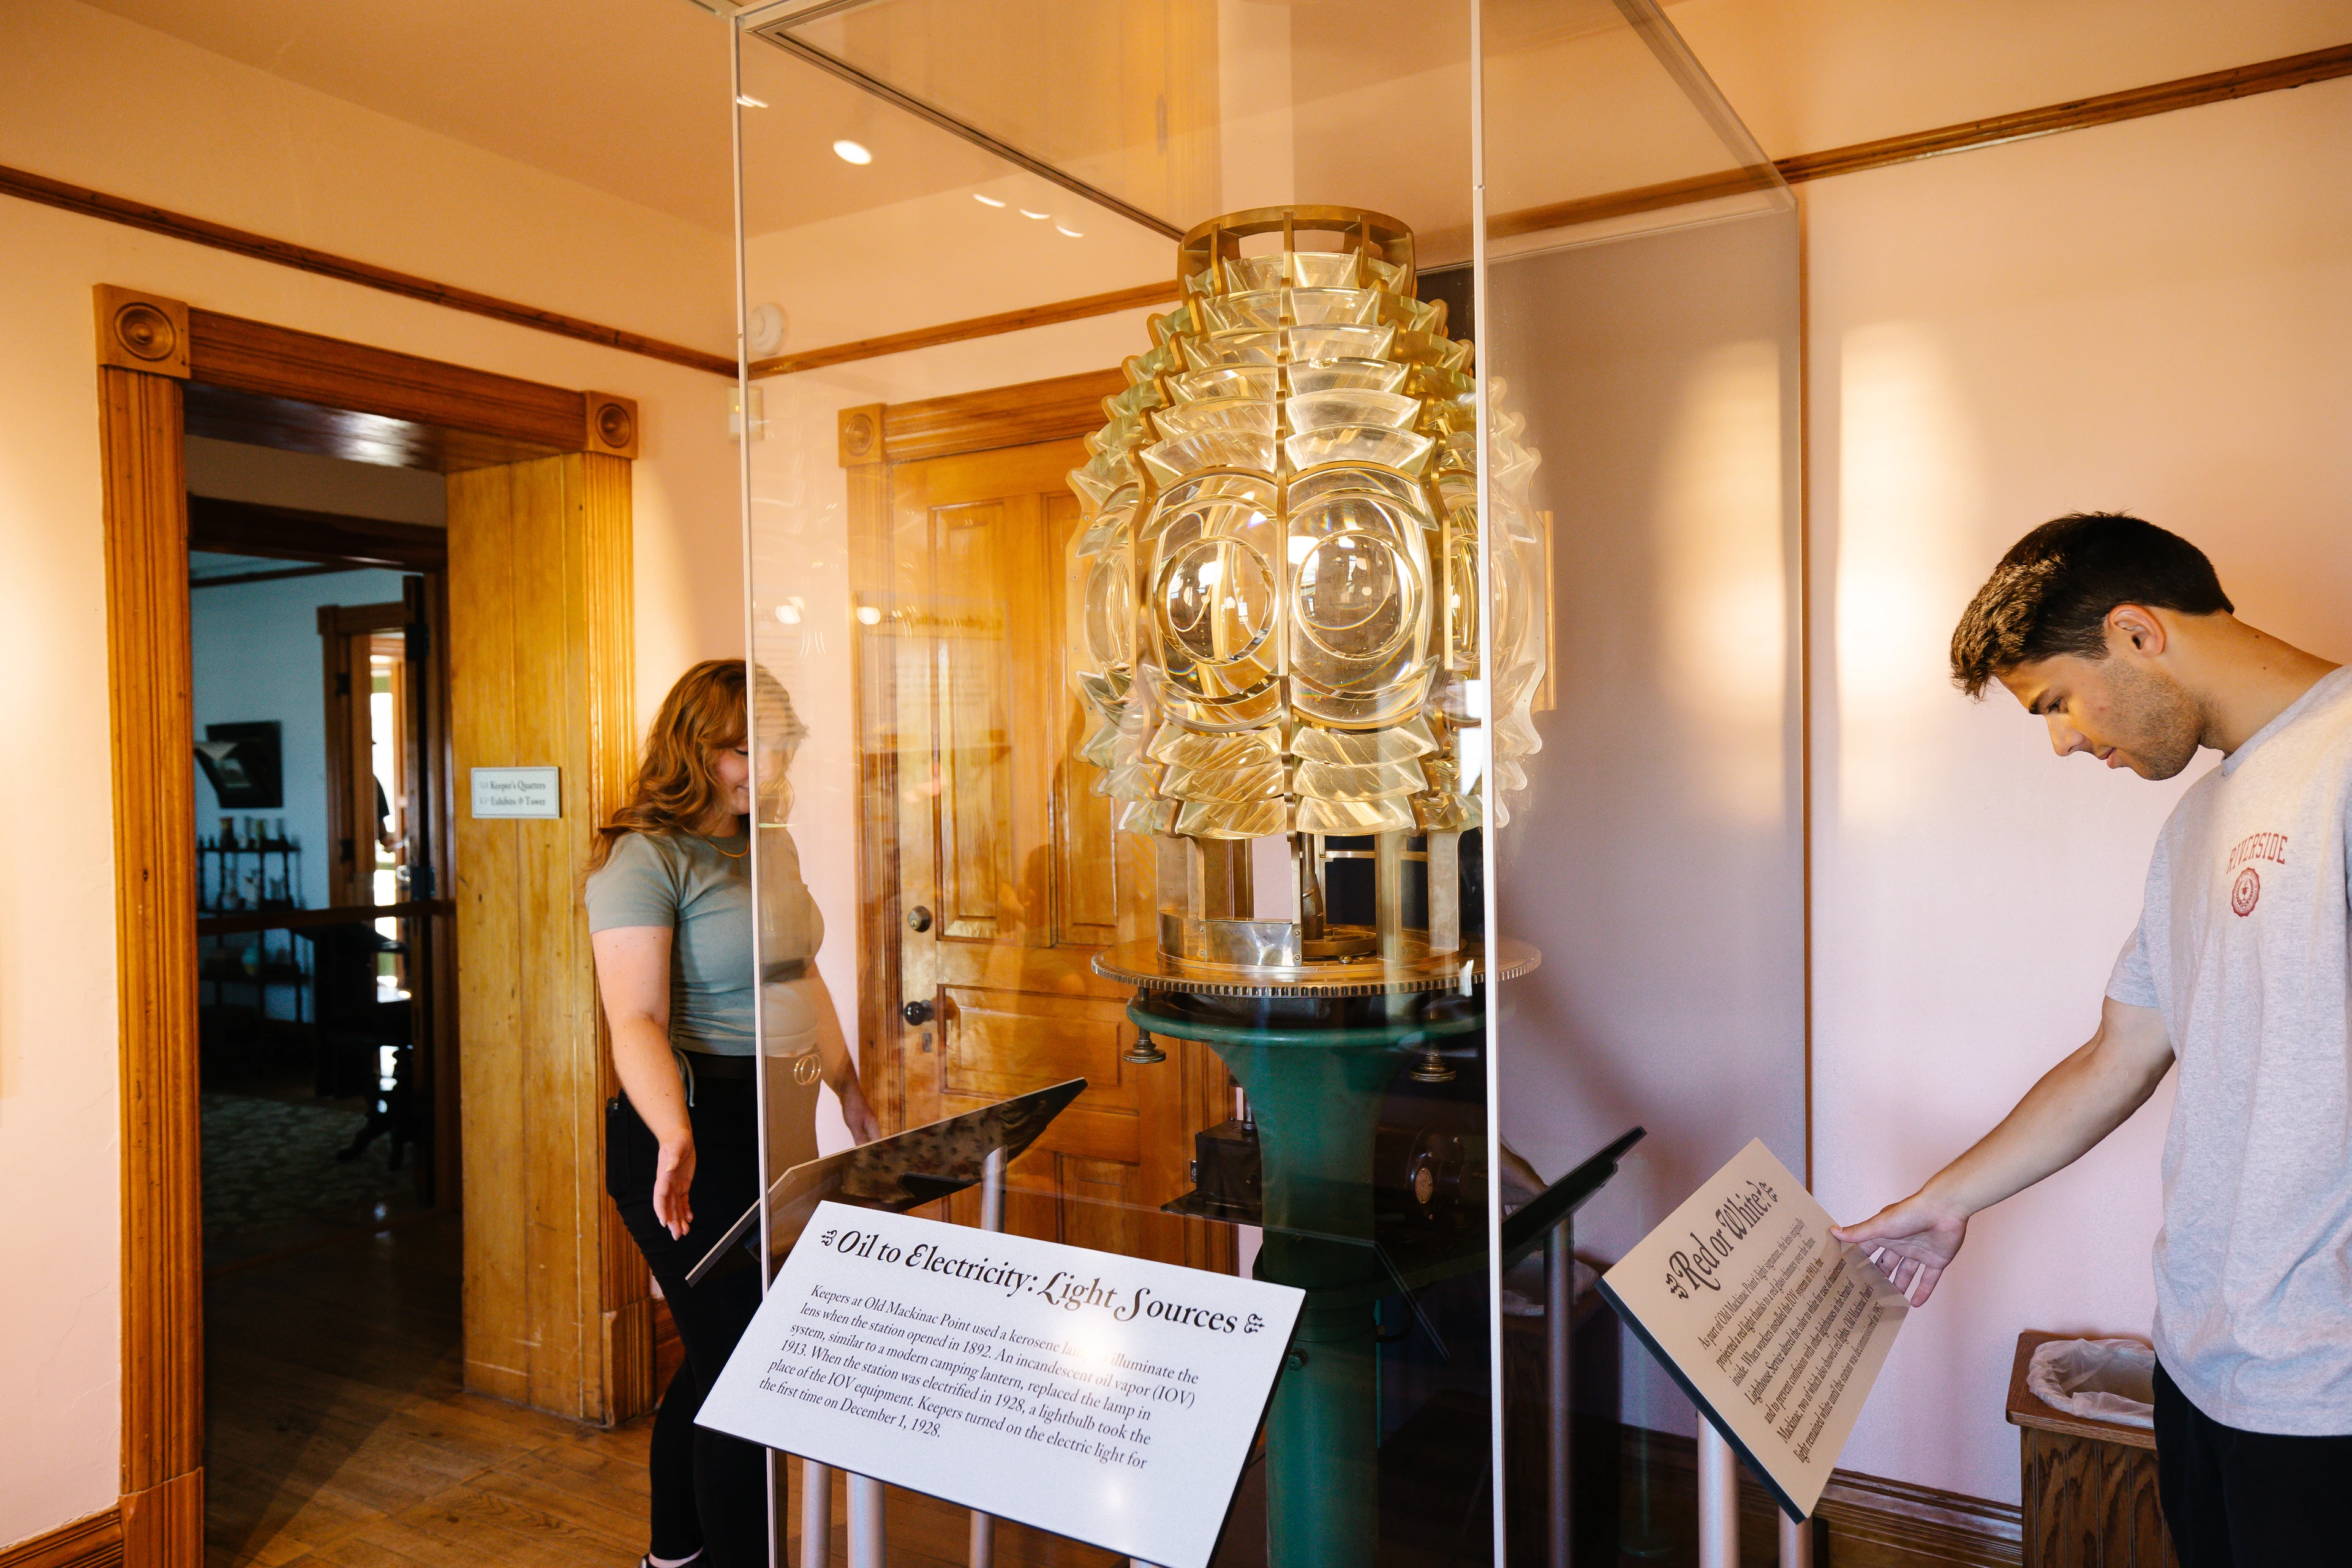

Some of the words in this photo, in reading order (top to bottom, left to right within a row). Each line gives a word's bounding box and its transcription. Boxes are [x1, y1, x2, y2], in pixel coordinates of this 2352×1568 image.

[489, 780, 516, 792] Keeper's
[517, 780, 546, 791] Quarters
[525, 796, 546, 805] Tower
[2226, 832, 2288, 875] RIVERSIDE
[1715, 1180, 1772, 1240] White?
[1709, 1228, 1735, 1257] or
[1776, 1241, 1788, 1252] the
[1781, 1234, 1793, 1246] lens
[1802, 1237, 1816, 1250] flame
[1763, 1249, 1784, 1271] signature,
[1794, 1252, 1804, 1264] over
[1798, 1246, 1809, 1256] the
[1668, 1232, 1721, 1291] Red
[1780, 1260, 1800, 1280] chimney
[1806, 1262, 1821, 1279] 1913,
[1813, 1257, 1824, 1268] the
[1753, 1265, 1768, 1281] light
[1802, 1274, 1812, 1284] in
[837, 1231, 880, 1258] Oil
[876, 1242, 902, 1263] to
[905, 1243, 1038, 1298] Electricity:
[1036, 1272, 1117, 1311] Light
[1113, 1287, 1238, 1334] Sources
[1741, 1273, 1760, 1294] Point's
[1770, 1282, 1779, 1298] red
[1773, 1276, 1786, 1294] glass
[1795, 1279, 1809, 1299] system
[1820, 1284, 1830, 1297] ease
[1823, 1276, 1833, 1289] of
[1847, 1276, 1855, 1289] of
[1762, 1297, 1771, 1306] to
[1784, 1288, 1799, 1308] IOV
[1812, 1292, 1824, 1304] for
[1837, 1284, 1852, 1302] Straits
[1724, 1289, 1749, 1316] Mackinac
[1749, 1300, 1767, 1321] thanks
[1781, 1302, 1792, 1314] the
[1806, 1299, 1820, 1315] white
[1830, 1304, 1841, 1314] in
[1833, 1297, 1844, 1308] the
[1848, 1297, 1867, 1322] Mackinac
[1714, 1316, 1724, 1331] of
[1717, 1307, 1732, 1325] Old
[1740, 1316, 1756, 1333] light
[1767, 1306, 1787, 1334] installed
[1796, 1316, 1809, 1332] color
[1803, 1311, 1812, 1321] to
[1815, 1309, 1838, 1338] lighthouses
[1843, 1313, 1856, 1329] Old
[810, 1284, 851, 1304] Keepers
[851, 1298, 864, 1306] at
[864, 1297, 888, 1312] Old
[884, 1301, 939, 1324] Mackinac
[939, 1313, 971, 1332] Point
[972, 1325, 1001, 1338] used
[999, 1332, 1007, 1340] a
[1008, 1329, 1060, 1352] kerosene
[1111, 1353, 1175, 1379] illuminate
[1177, 1368, 1199, 1384] the
[1706, 1326, 1720, 1346] part
[1734, 1336, 1741, 1344] a
[1737, 1324, 1747, 1341] red
[1756, 1329, 1774, 1352] workers
[1789, 1327, 1801, 1340] the
[1809, 1332, 1823, 1349] other
[1834, 1327, 1851, 1344] lights.
[1851, 1316, 1877, 1357] decommissioned
[1698, 1336, 1711, 1351] As
[1779, 1332, 1796, 1357] altered
[1803, 1343, 1815, 1360] with
[1833, 1335, 1843, 1352] red
[800, 1302, 821, 1317] lens
[823, 1309, 850, 1324] when
[850, 1314, 869, 1329] the
[869, 1322, 905, 1338] station
[907, 1332, 949, 1348] opened
[948, 1337, 960, 1351] in
[962, 1341, 992, 1359] 1892.
[993, 1348, 1014, 1364] An
[1014, 1353, 1093, 1382] incandescent
[1095, 1374, 1114, 1387] oil
[1115, 1381, 1151, 1396] vapor
[1152, 1385, 1196, 1409] (IOV)
[1716, 1335, 1738, 1373] projected
[1741, 1348, 1761, 1368] When
[1765, 1352, 1785, 1374] Service
[1821, 1344, 1838, 1370] showed
[1849, 1354, 1858, 1366] was
[790, 1324, 826, 1342] system,
[828, 1332, 865, 1349] similar
[865, 1341, 877, 1352] to
[886, 1348, 929, 1365] modern
[930, 1359, 979, 1381] camping
[979, 1366, 1023, 1391] lantern,
[1027, 1382, 1080, 1402] replaced
[1080, 1392, 1101, 1408] the
[1102, 1396, 1136, 1419] lamp
[1137, 1406, 1151, 1421] in
[1728, 1364, 1749, 1387] inside.
[1789, 1357, 1808, 1385] confusion
[1815, 1366, 1828, 1381] also
[1840, 1363, 1854, 1384] station
[780, 1340, 807, 1356] 1913.
[811, 1346, 842, 1365] When
[843, 1355, 861, 1370] the
[861, 1363, 899, 1380] station
[901, 1373, 921, 1385] was
[922, 1376, 981, 1400] electrified
[979, 1390, 992, 1404] in
[994, 1393, 1025, 1415] 1928,
[1028, 1406, 1036, 1415] a
[1038, 1404, 1095, 1430] lightbulb
[1098, 1423, 1128, 1439] took
[1129, 1428, 1151, 1445] the
[1744, 1370, 1773, 1406] Lighthouse
[1807, 1373, 1822, 1395] which
[1833, 1379, 1845, 1392] the
[1776, 1380, 1793, 1410] prevent
[1803, 1385, 1813, 1402] of
[1828, 1384, 1840, 1405] until
[759, 1377, 777, 1392] the
[776, 1381, 799, 1398] first
[799, 1389, 823, 1404] time
[824, 1398, 839, 1409] on
[839, 1397, 897, 1425] December
[897, 1414, 907, 1430] 1,
[911, 1418, 941, 1438] 1928.
[767, 1359, 796, 1374] place
[796, 1366, 813, 1378] of
[809, 1368, 827, 1383] the
[827, 1372, 857, 1389] IOV
[854, 1384, 914, 1407] equipment.
[917, 1395, 963, 1419] Keepers
[965, 1411, 1006, 1431] turned
[1006, 1424, 1022, 1436] on
[1024, 1425, 1045, 1441] the
[1046, 1431, 1092, 1454] electric
[1093, 1442, 1125, 1463] light
[1127, 1451, 1148, 1469] for
[1764, 1404, 1776, 1425] and
[1771, 1401, 1780, 1412] to
[1797, 1398, 1809, 1413] two
[1819, 1401, 1833, 1420] white
[1776, 1410, 1805, 1444] Mackinac,
[1805, 1412, 1825, 1448] remained
[1793, 1442, 1811, 1463] light
